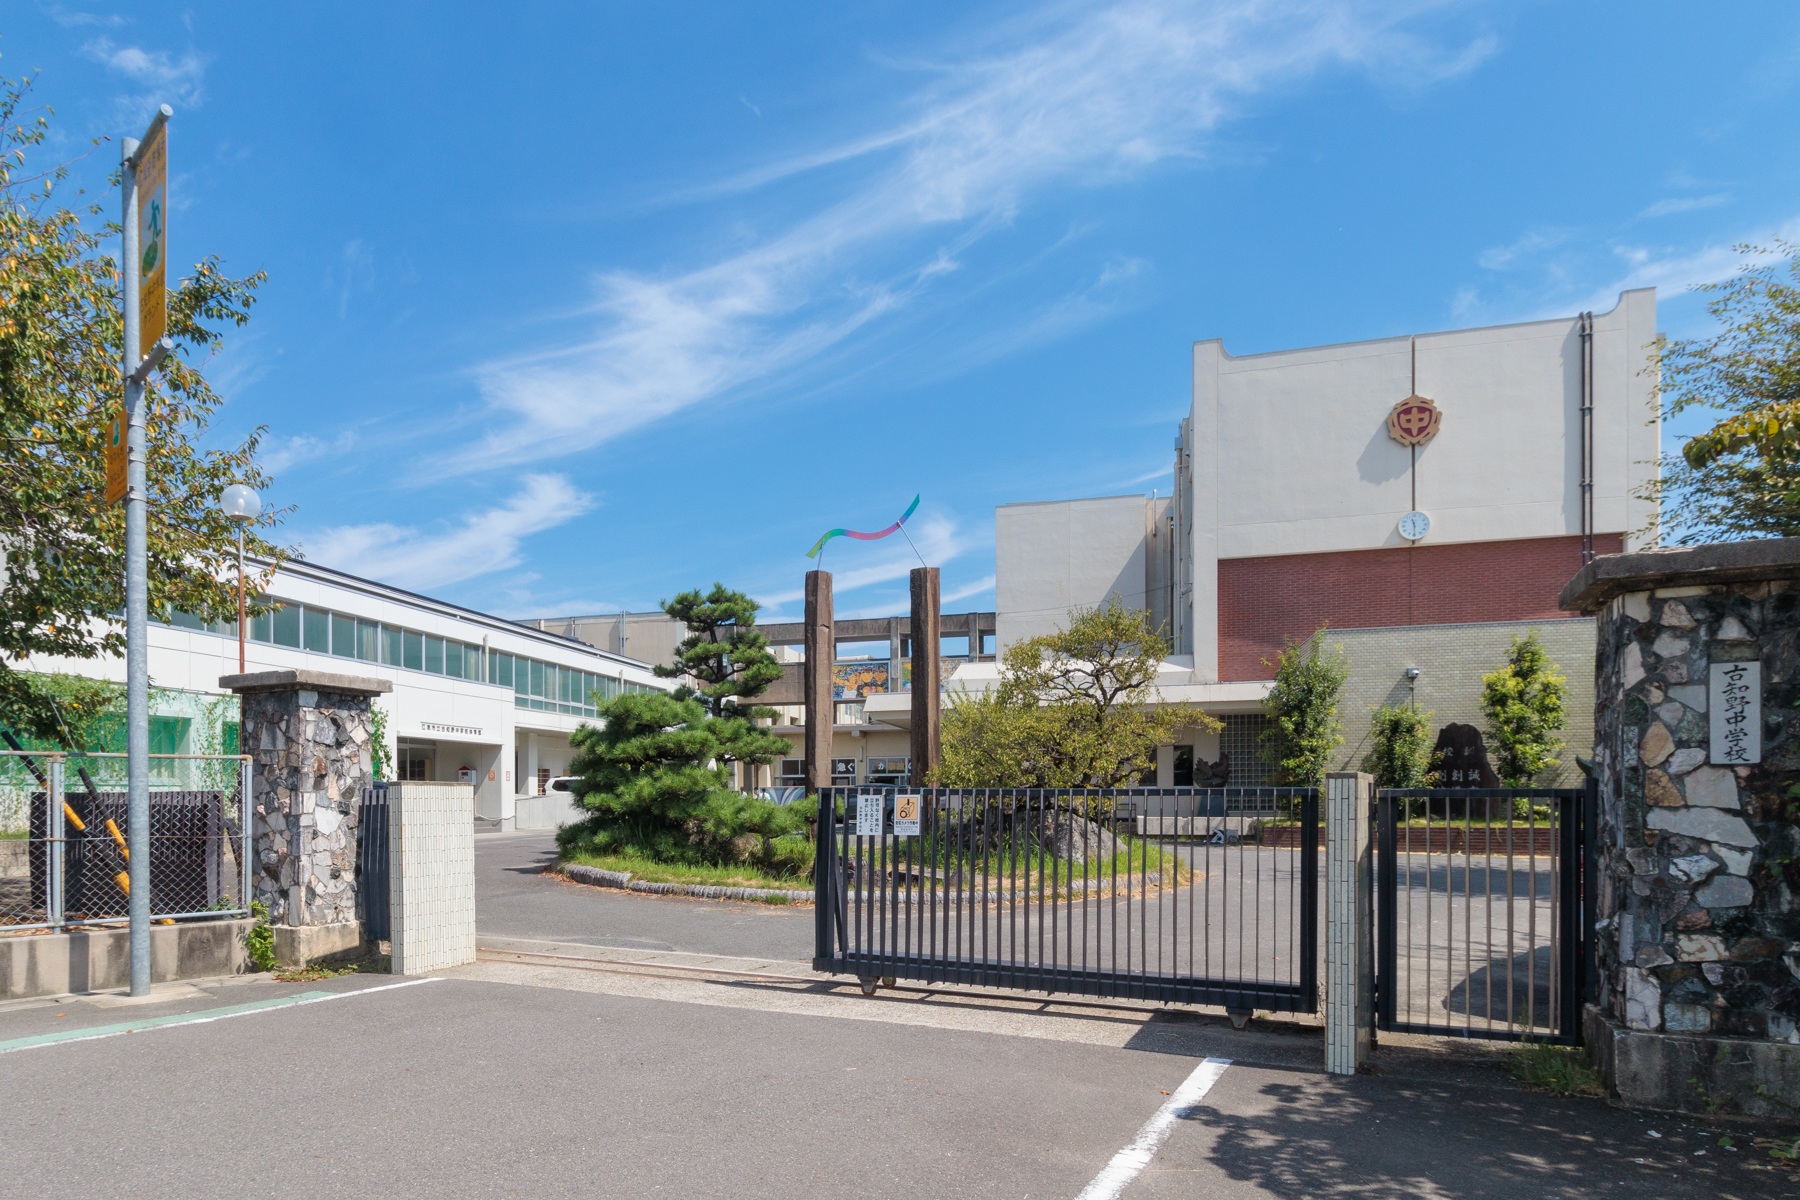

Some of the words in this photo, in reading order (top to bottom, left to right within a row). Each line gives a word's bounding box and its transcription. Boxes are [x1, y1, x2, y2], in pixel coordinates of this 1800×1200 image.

[1722, 664, 1751, 762] 古知野中学校
